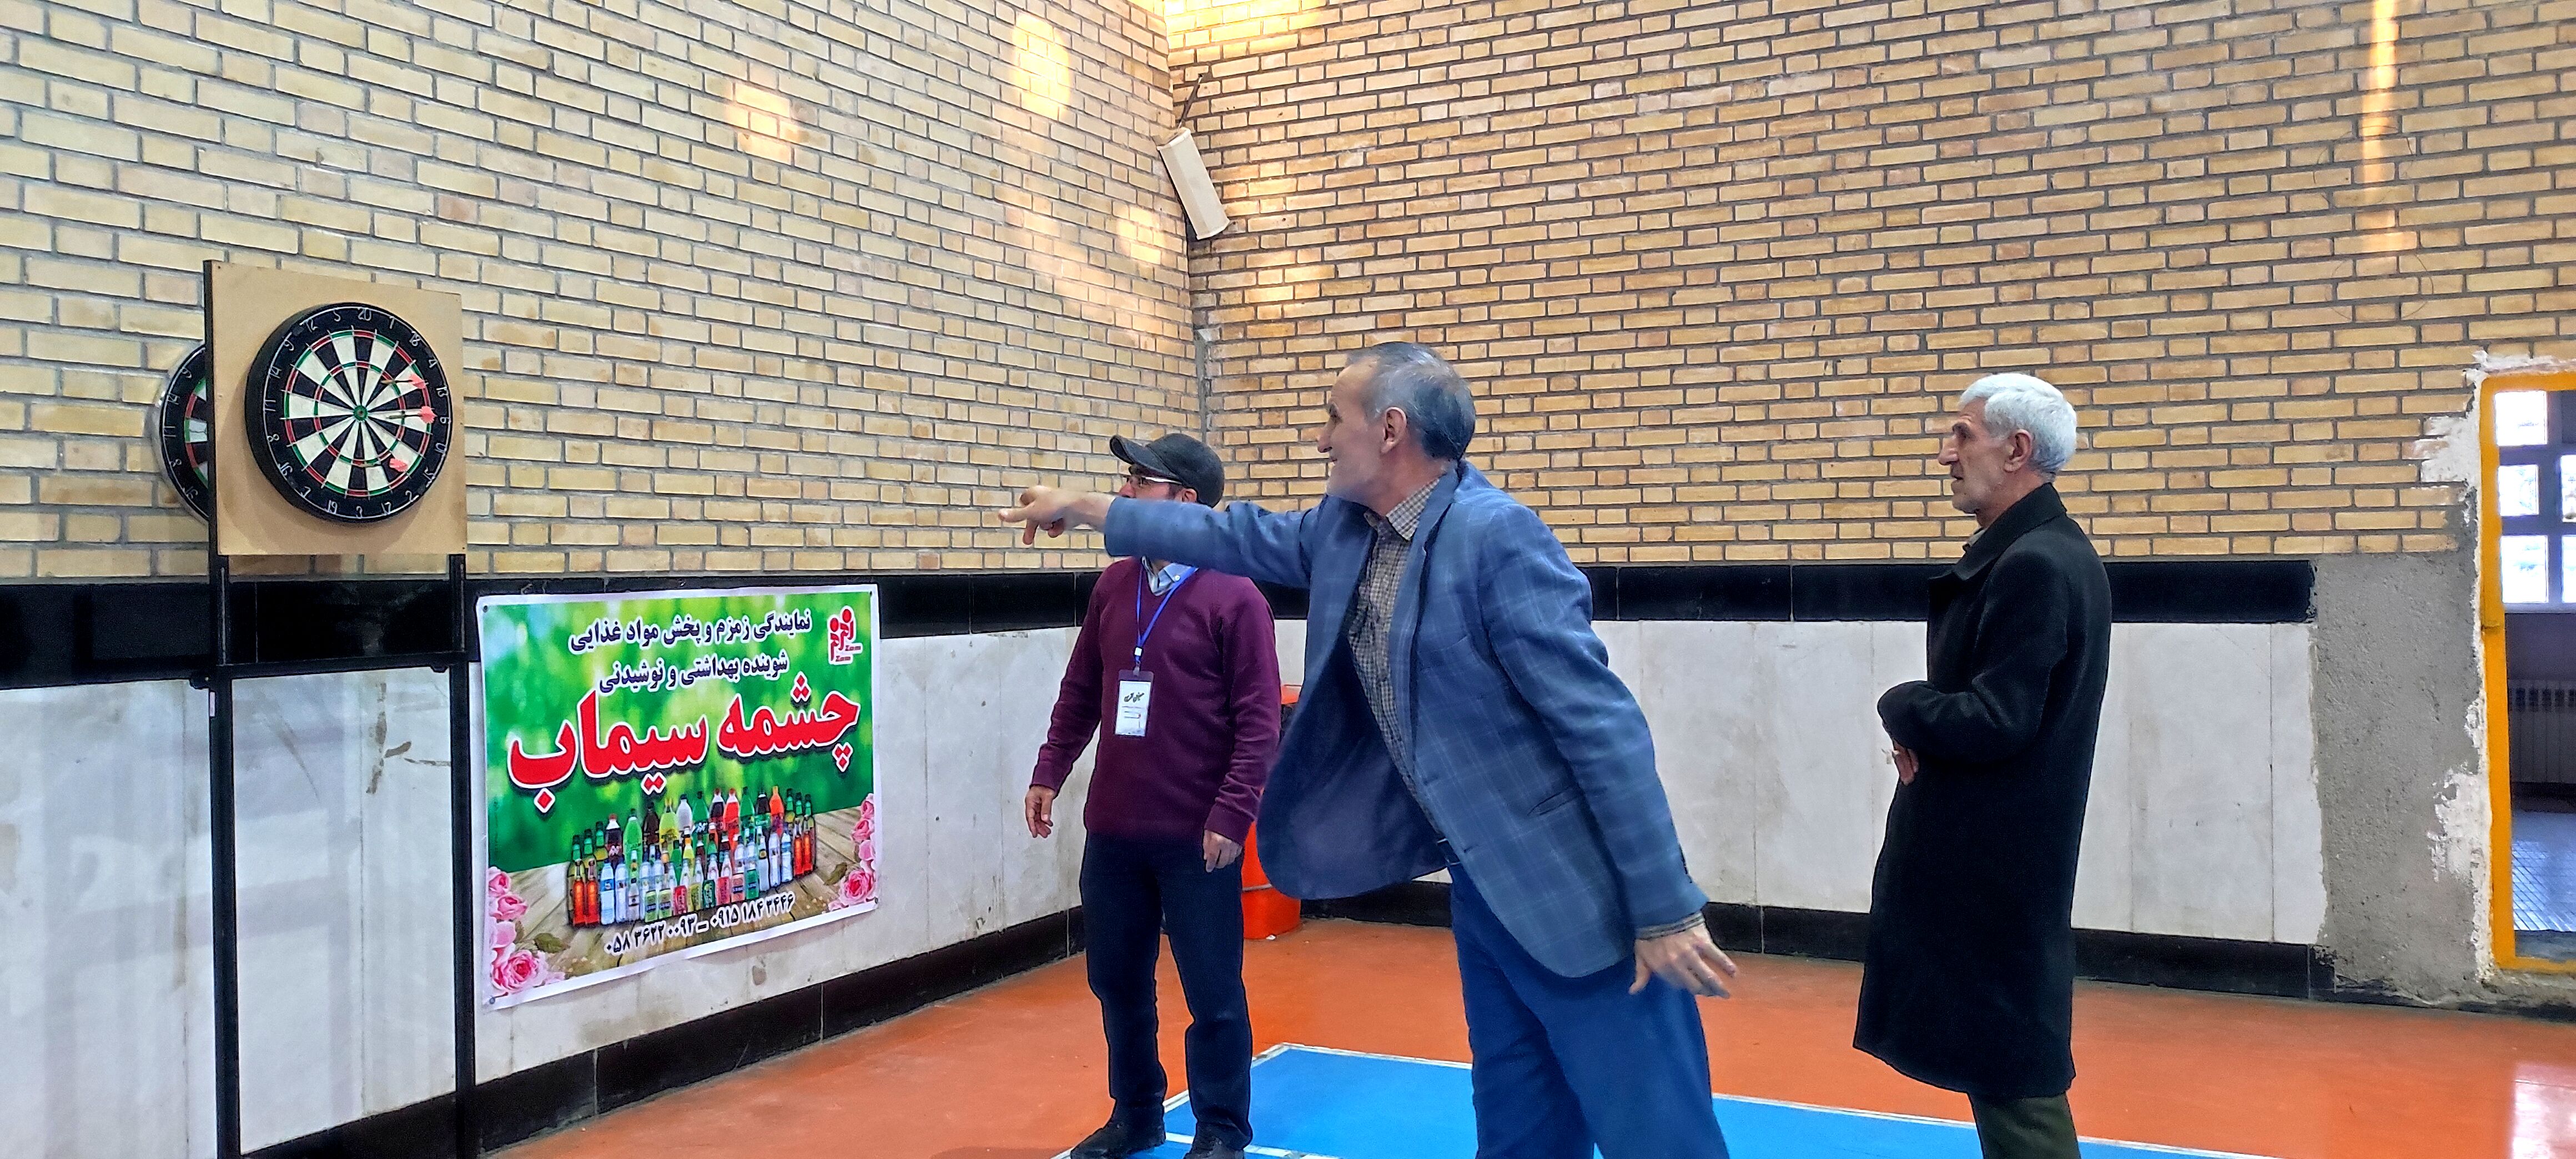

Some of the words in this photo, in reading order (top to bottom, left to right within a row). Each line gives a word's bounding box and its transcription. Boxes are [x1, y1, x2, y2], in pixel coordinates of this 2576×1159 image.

[306, 319, 319, 332] 12
[333, 309, 341, 321] 5
[358, 308, 371, 321] 20
[269, 366, 281, 379] 14
[428, 359, 437, 368] 4
[436, 386, 449, 397] 13
[264, 399, 276, 412] 11
[267, 434, 280, 442] 8
[355, 506, 363, 519] 3
[571, 620, 622, 652] غذایی
[626, 619, 659, 647] مواد
[663, 616, 701, 645] پخش
[705, 624, 712, 643] و
[716, 618, 749, 642] زمزم
[753, 611, 811, 639] نمایندگی
[681, 656, 739, 686] بهداشتی
[743, 652, 788, 678] شوینده
[599, 661, 663, 693] نوشیدنی
[668, 668, 676, 688] و
[720, 675, 861, 770] چشمه
[509, 692, 708, 810] سیماب
[606, 935, 631, 953] ۰۵۸
[712, 907, 739, 926] ۰۹۱۵
[743, 900, 764, 920] ۱۸۴
